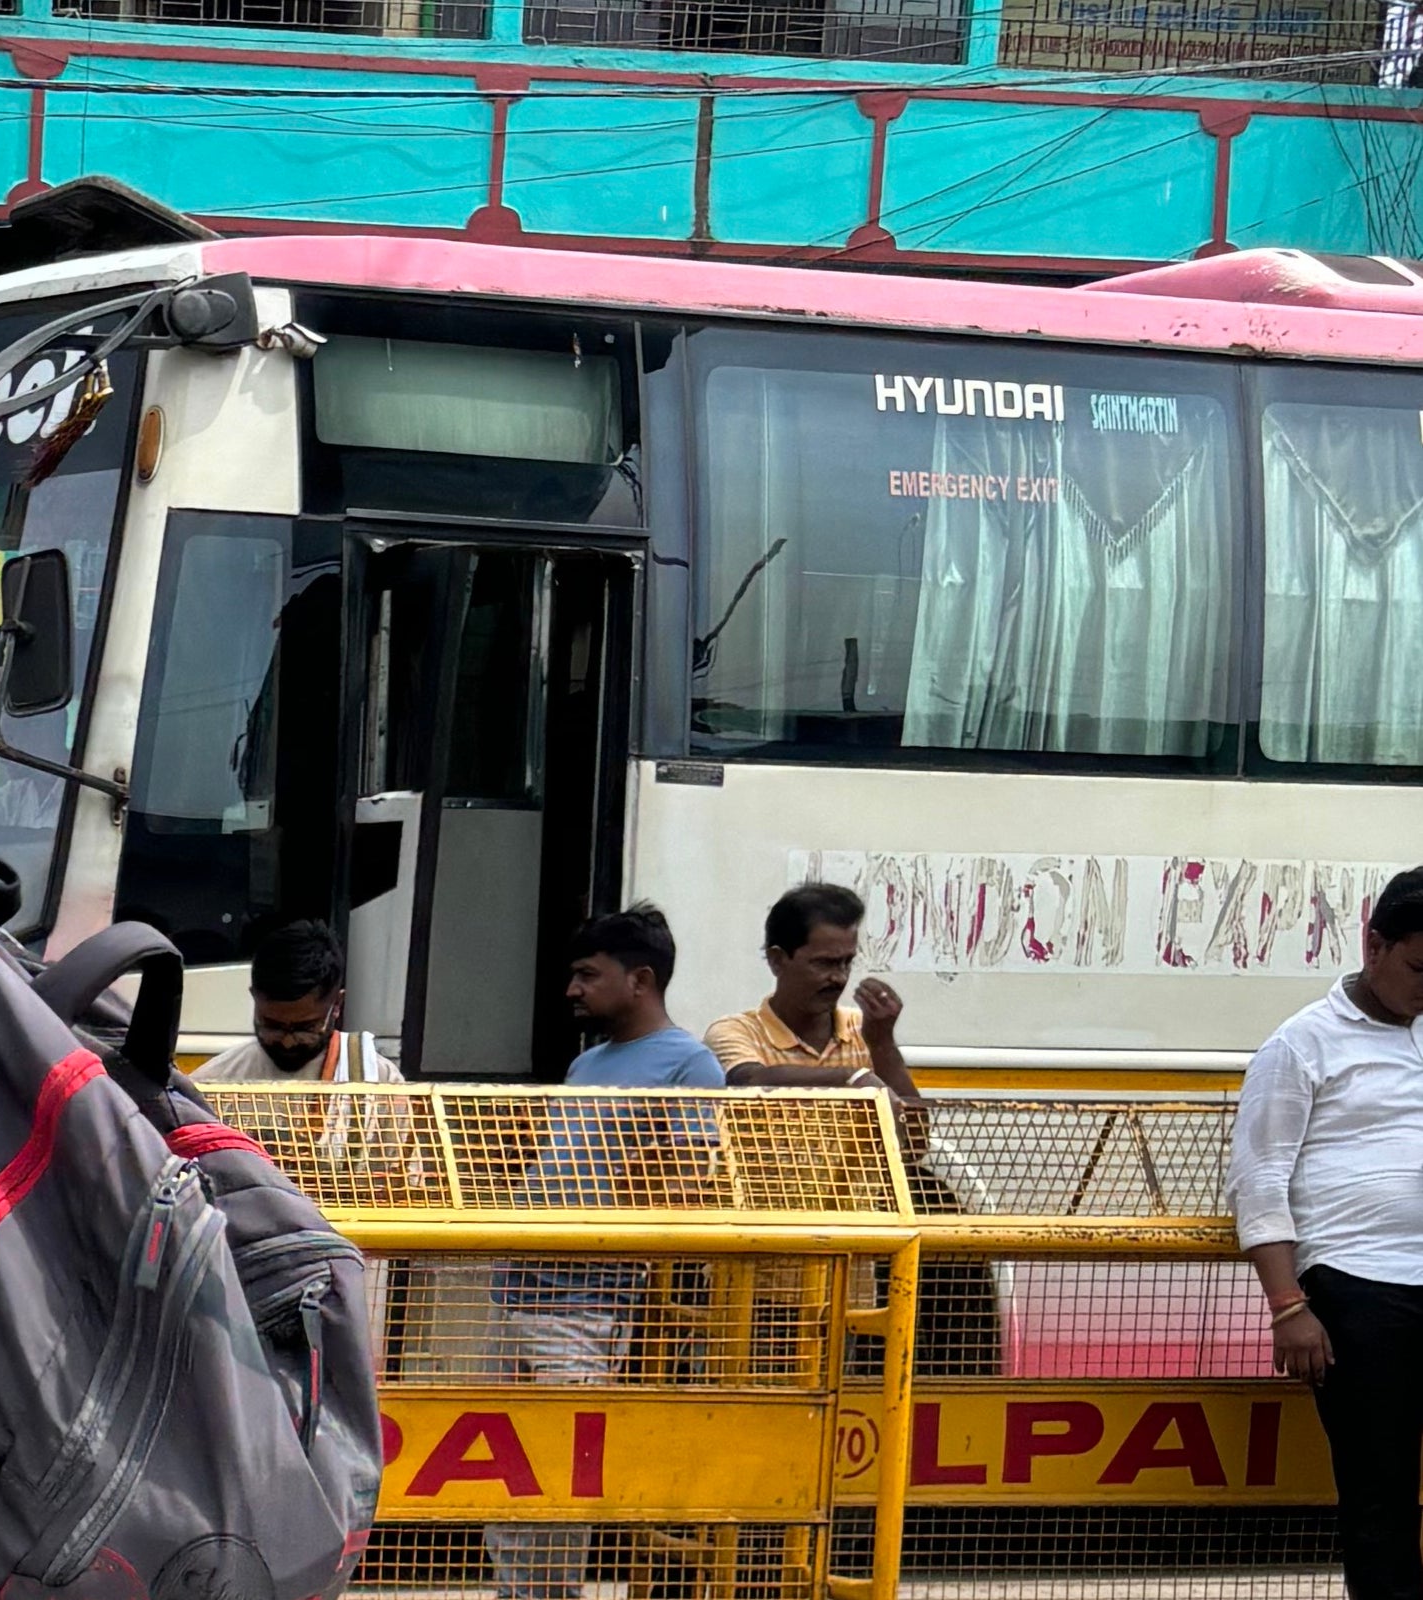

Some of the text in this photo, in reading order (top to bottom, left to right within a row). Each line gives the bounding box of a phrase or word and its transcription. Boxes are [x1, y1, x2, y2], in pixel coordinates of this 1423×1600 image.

[874, 373, 1065, 421] HYUNDAI
[889, 470, 1060, 502] EMERGENCY EXIT
[807, 850, 1130, 970] ONDON
[382, 1411, 606, 1498] AI
[909, 1401, 1282, 1488] LPAI
